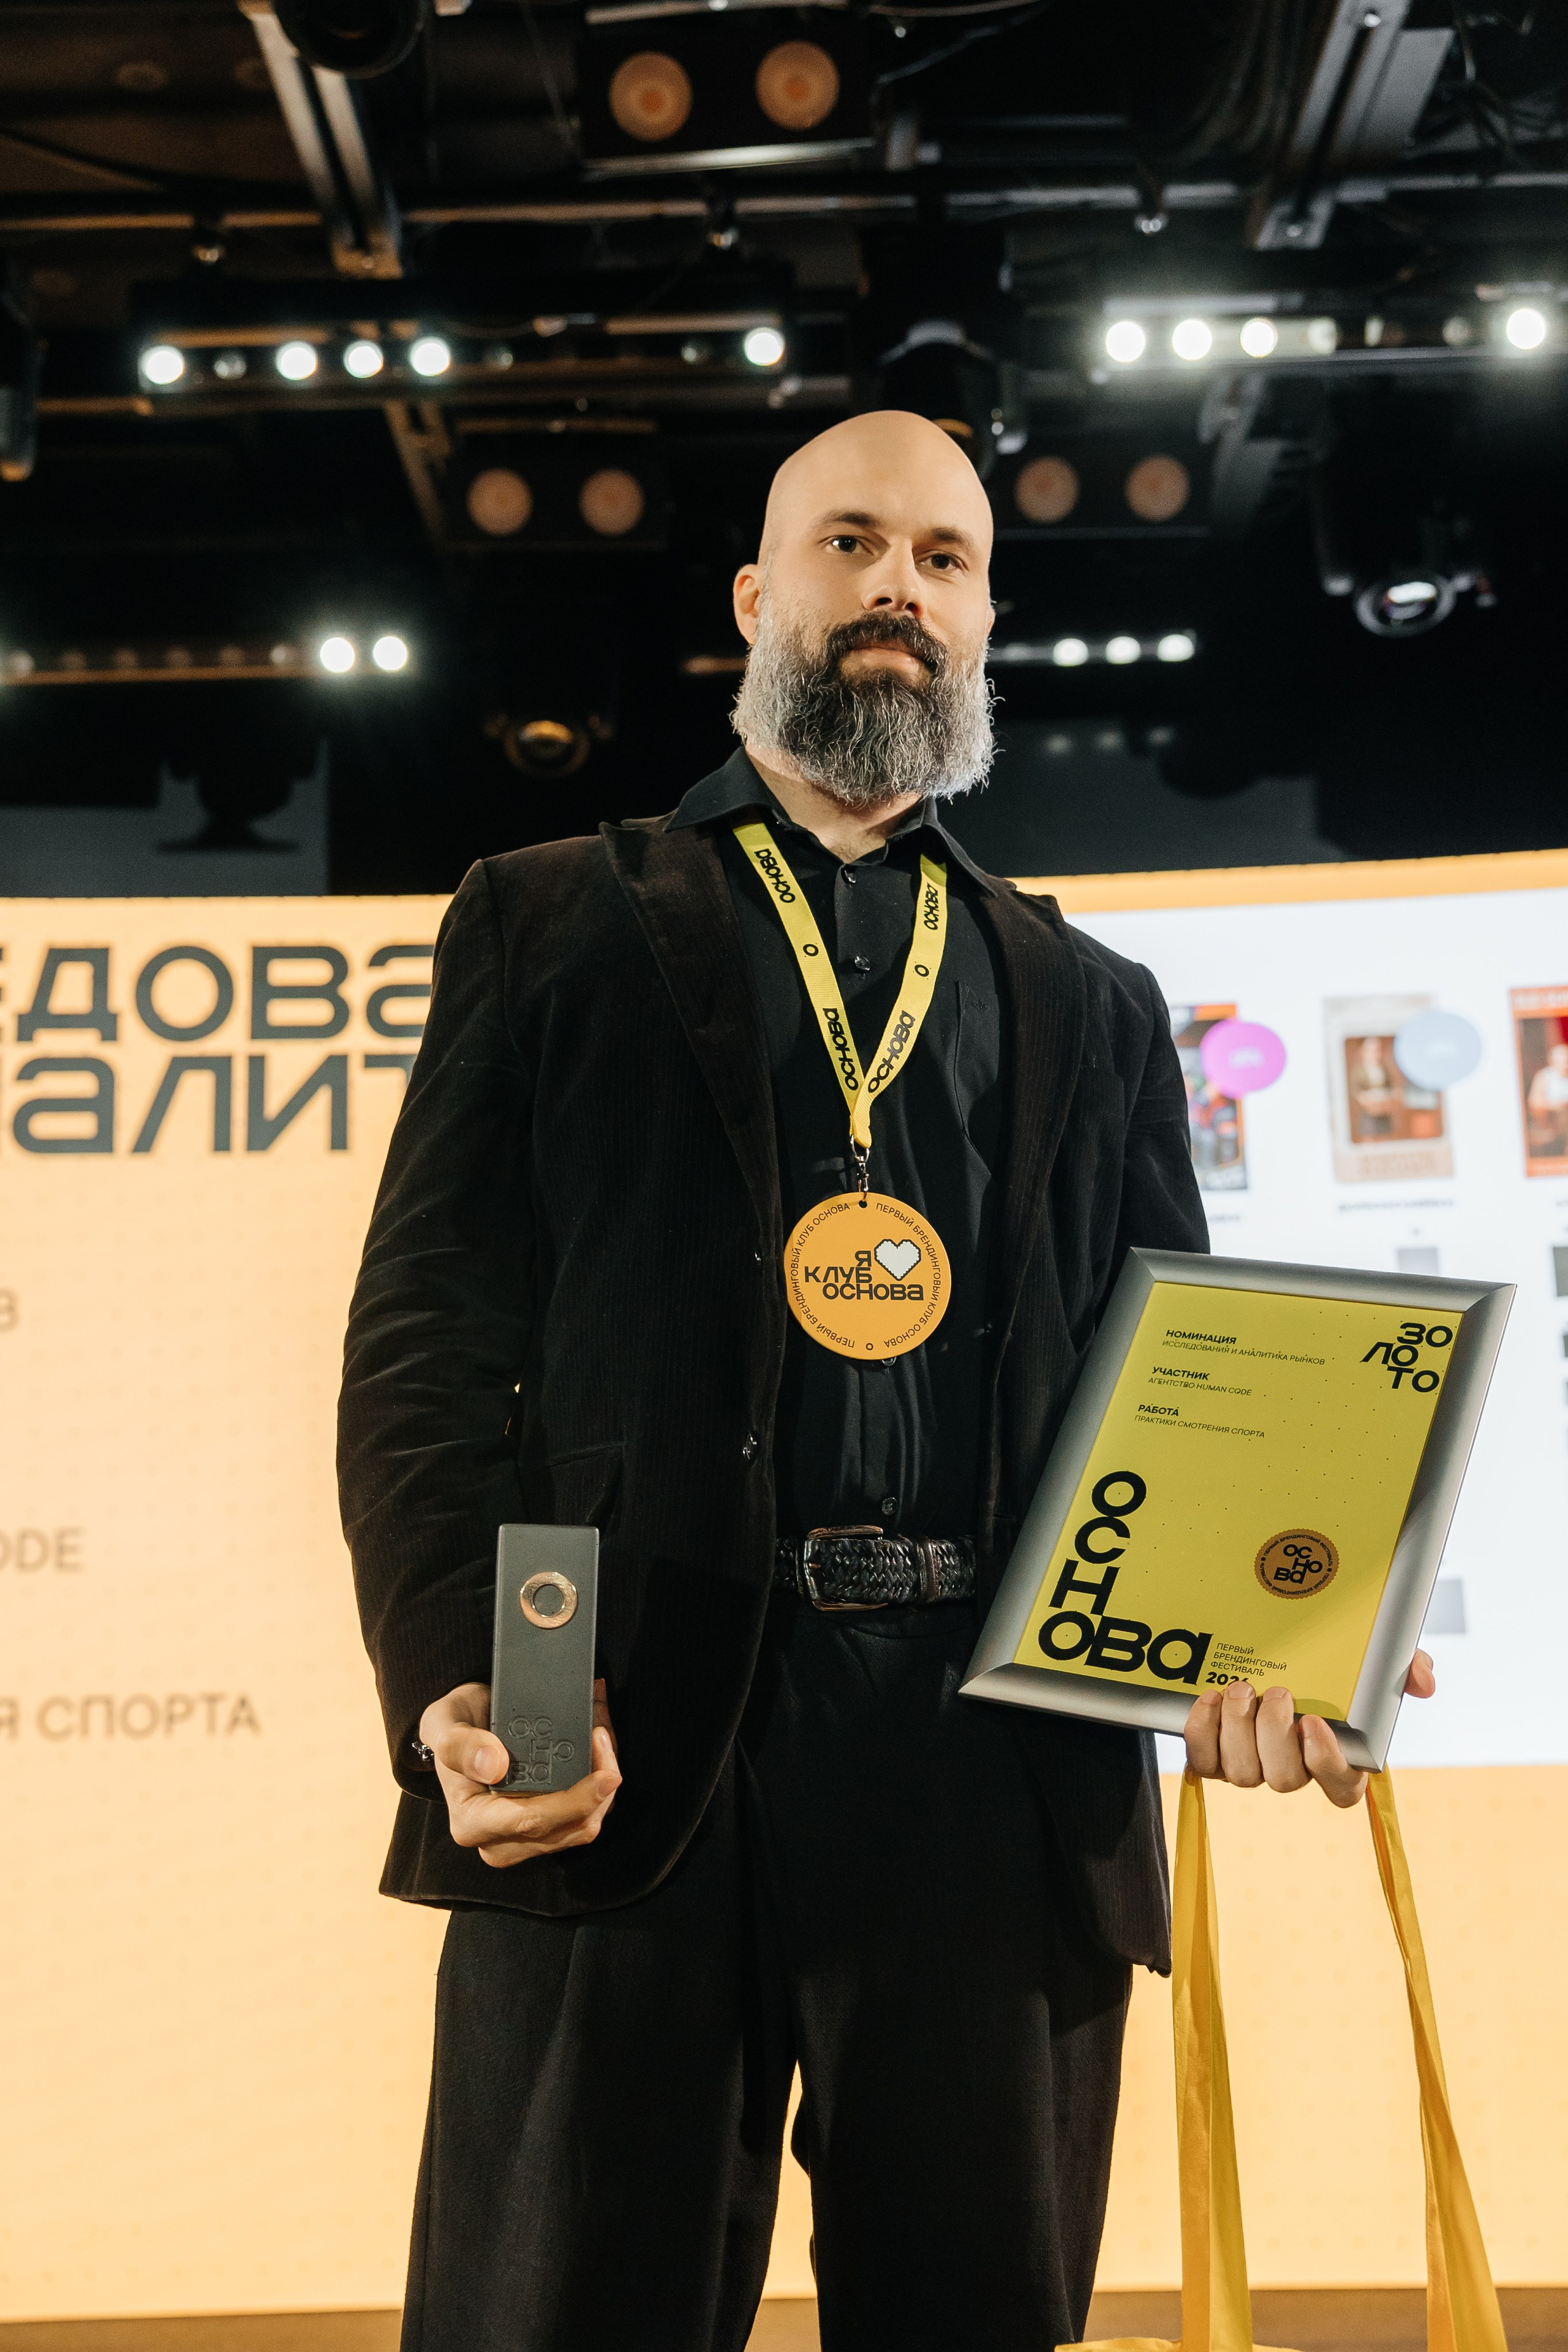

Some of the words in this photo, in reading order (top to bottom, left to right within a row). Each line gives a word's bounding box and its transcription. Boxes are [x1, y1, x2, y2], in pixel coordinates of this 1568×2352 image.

[812, 1202, 850, 1226] ОСНОВА
[876, 1202, 914, 1227] ПЕРВЫЙ
[796, 1224, 814, 1247] КЛУБ
[854, 1250, 872, 1267] Я
[790, 1248, 818, 1325] БРЕНДИНГОВЫЙ
[804, 1266, 873, 1284] КЛУБ
[919, 1302, 937, 1325] КЛУБ
[816, 1322, 856, 1348] ПЕРВЫЙ
[883, 1323, 921, 1348] ОСНОВА
[1166, 1329, 1237, 1345] НОМИНАЦИЯ
[1162, 1340, 1230, 1354] ИССЛЕДОВАНИЯ
[1238, 1348, 1288, 1361] АНАЛИТИКА
[1289, 1354, 1325, 1365] РЫНКОВ
[1152, 1366, 1211, 1381] УЧАСТНИК
[1147, 1377, 1196, 1389] АГЕНТСТВО
[1196, 1383, 1227, 1393] HUMAN
[1228, 1387, 1253, 1396] CODE
[1137, 1404, 1180, 1417] РАБОТА
[1134, 1414, 1177, 1427] ПРАКТИКИ
[1177, 1420, 1231, 1434] СМОТРЕНИЯ
[1231, 1427, 1265, 1438] СПОРТА
[0, 1526, 85, 1574] DE
[1263, 1540, 1280, 1556] ПЕРВЫЙ
[1216, 1642, 1254, 1655] ПЕРВЫЙ
[1210, 1661, 1265, 1676] ФЕСТИВАЛЬ
[1213, 1651, 1287, 1671] БРЕНДИНГОВЫЙ
[35, 1692, 262, 1742] СПОРТА
